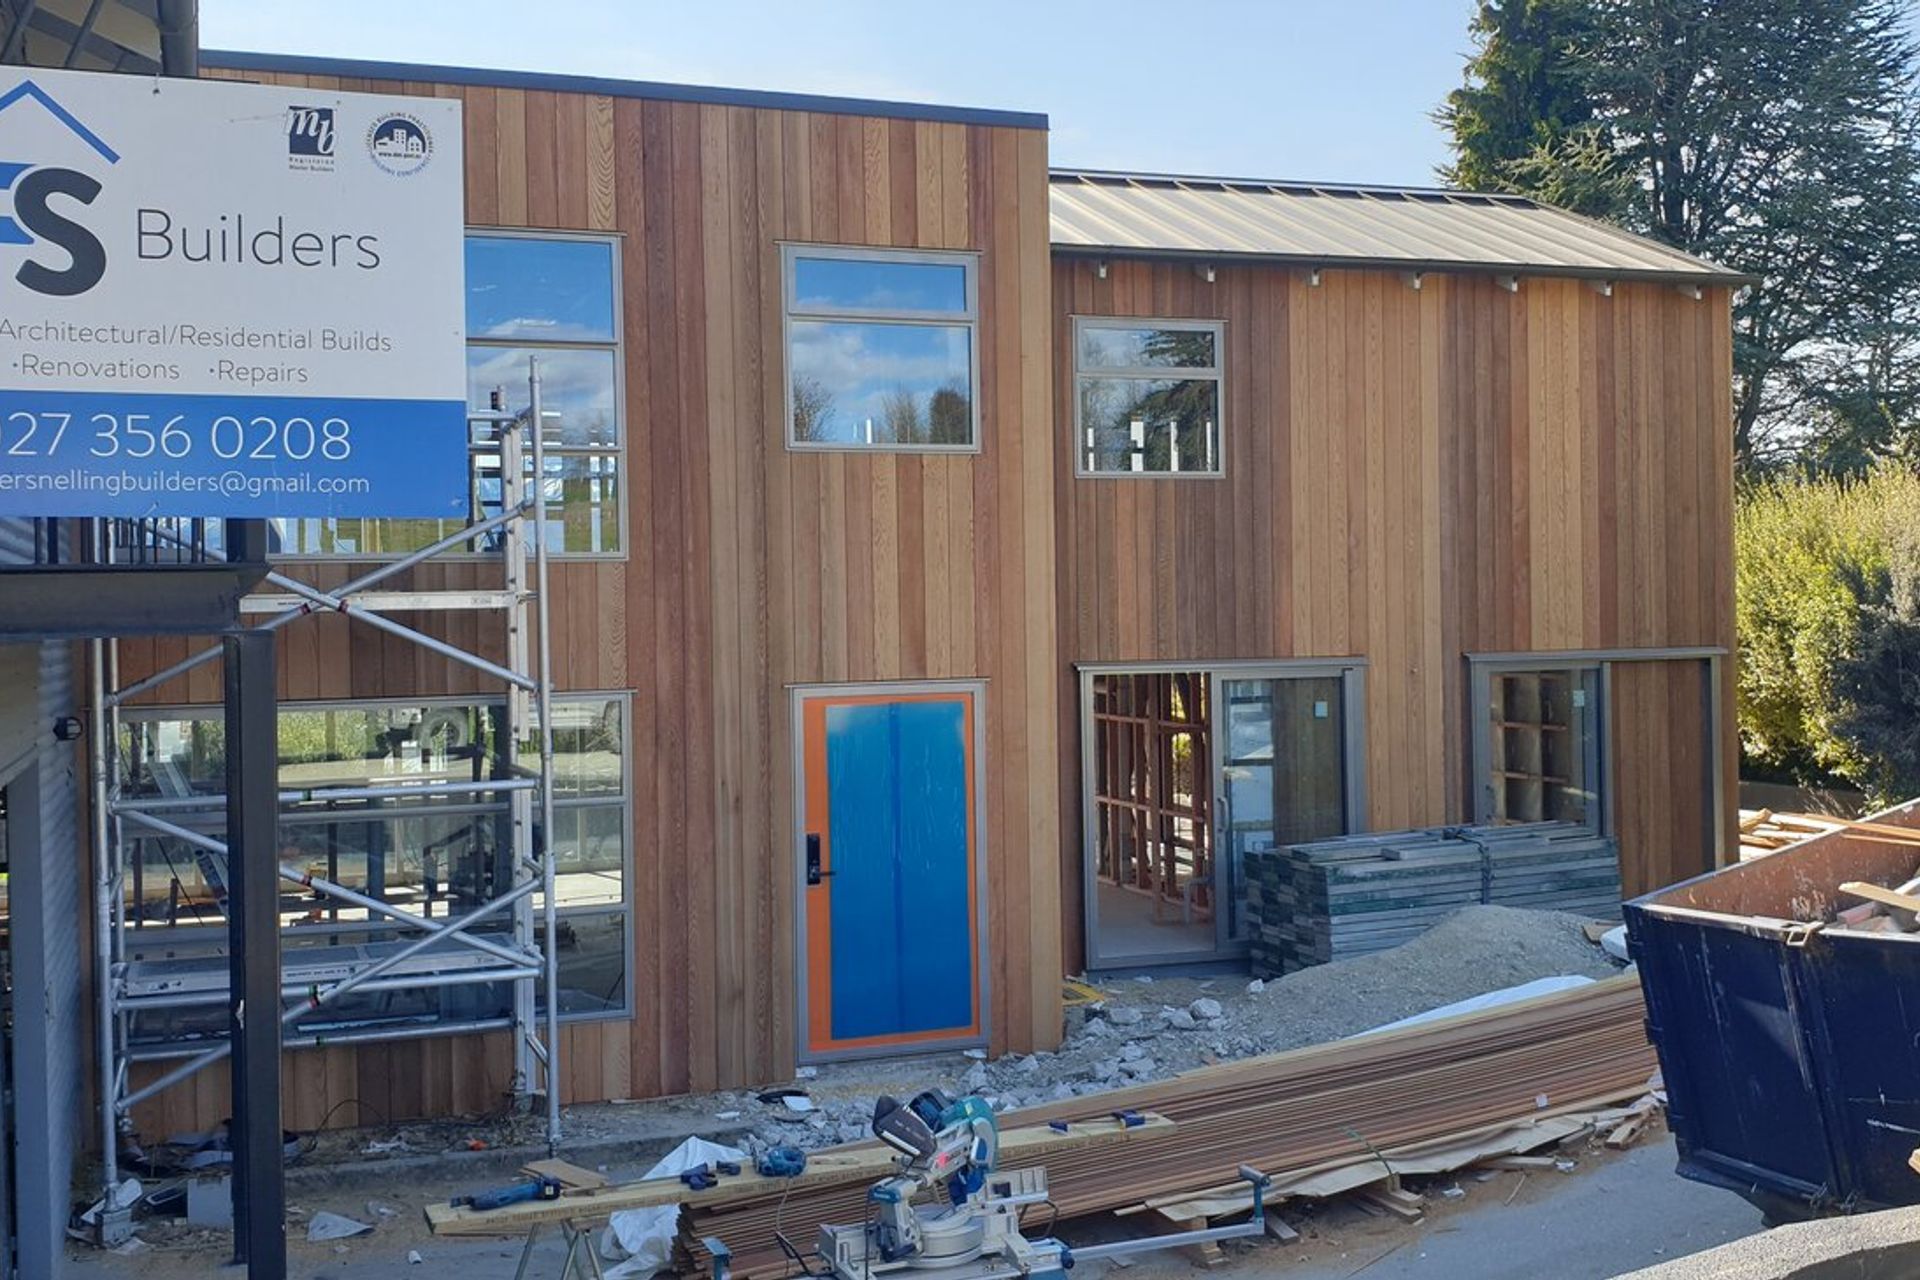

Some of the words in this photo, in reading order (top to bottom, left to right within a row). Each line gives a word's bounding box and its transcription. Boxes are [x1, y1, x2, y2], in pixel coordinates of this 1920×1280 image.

[137, 208, 381, 270] Builders
[0, 318, 312, 350] Architectural/Residential
[321, 328, 393, 352] Builds
[0, 412, 72, 457] 27
[90, 413, 192, 458] 356
[211, 416, 352, 460] 0208
[0, 469, 371, 498] ersnellingbuilders@gmail.com
